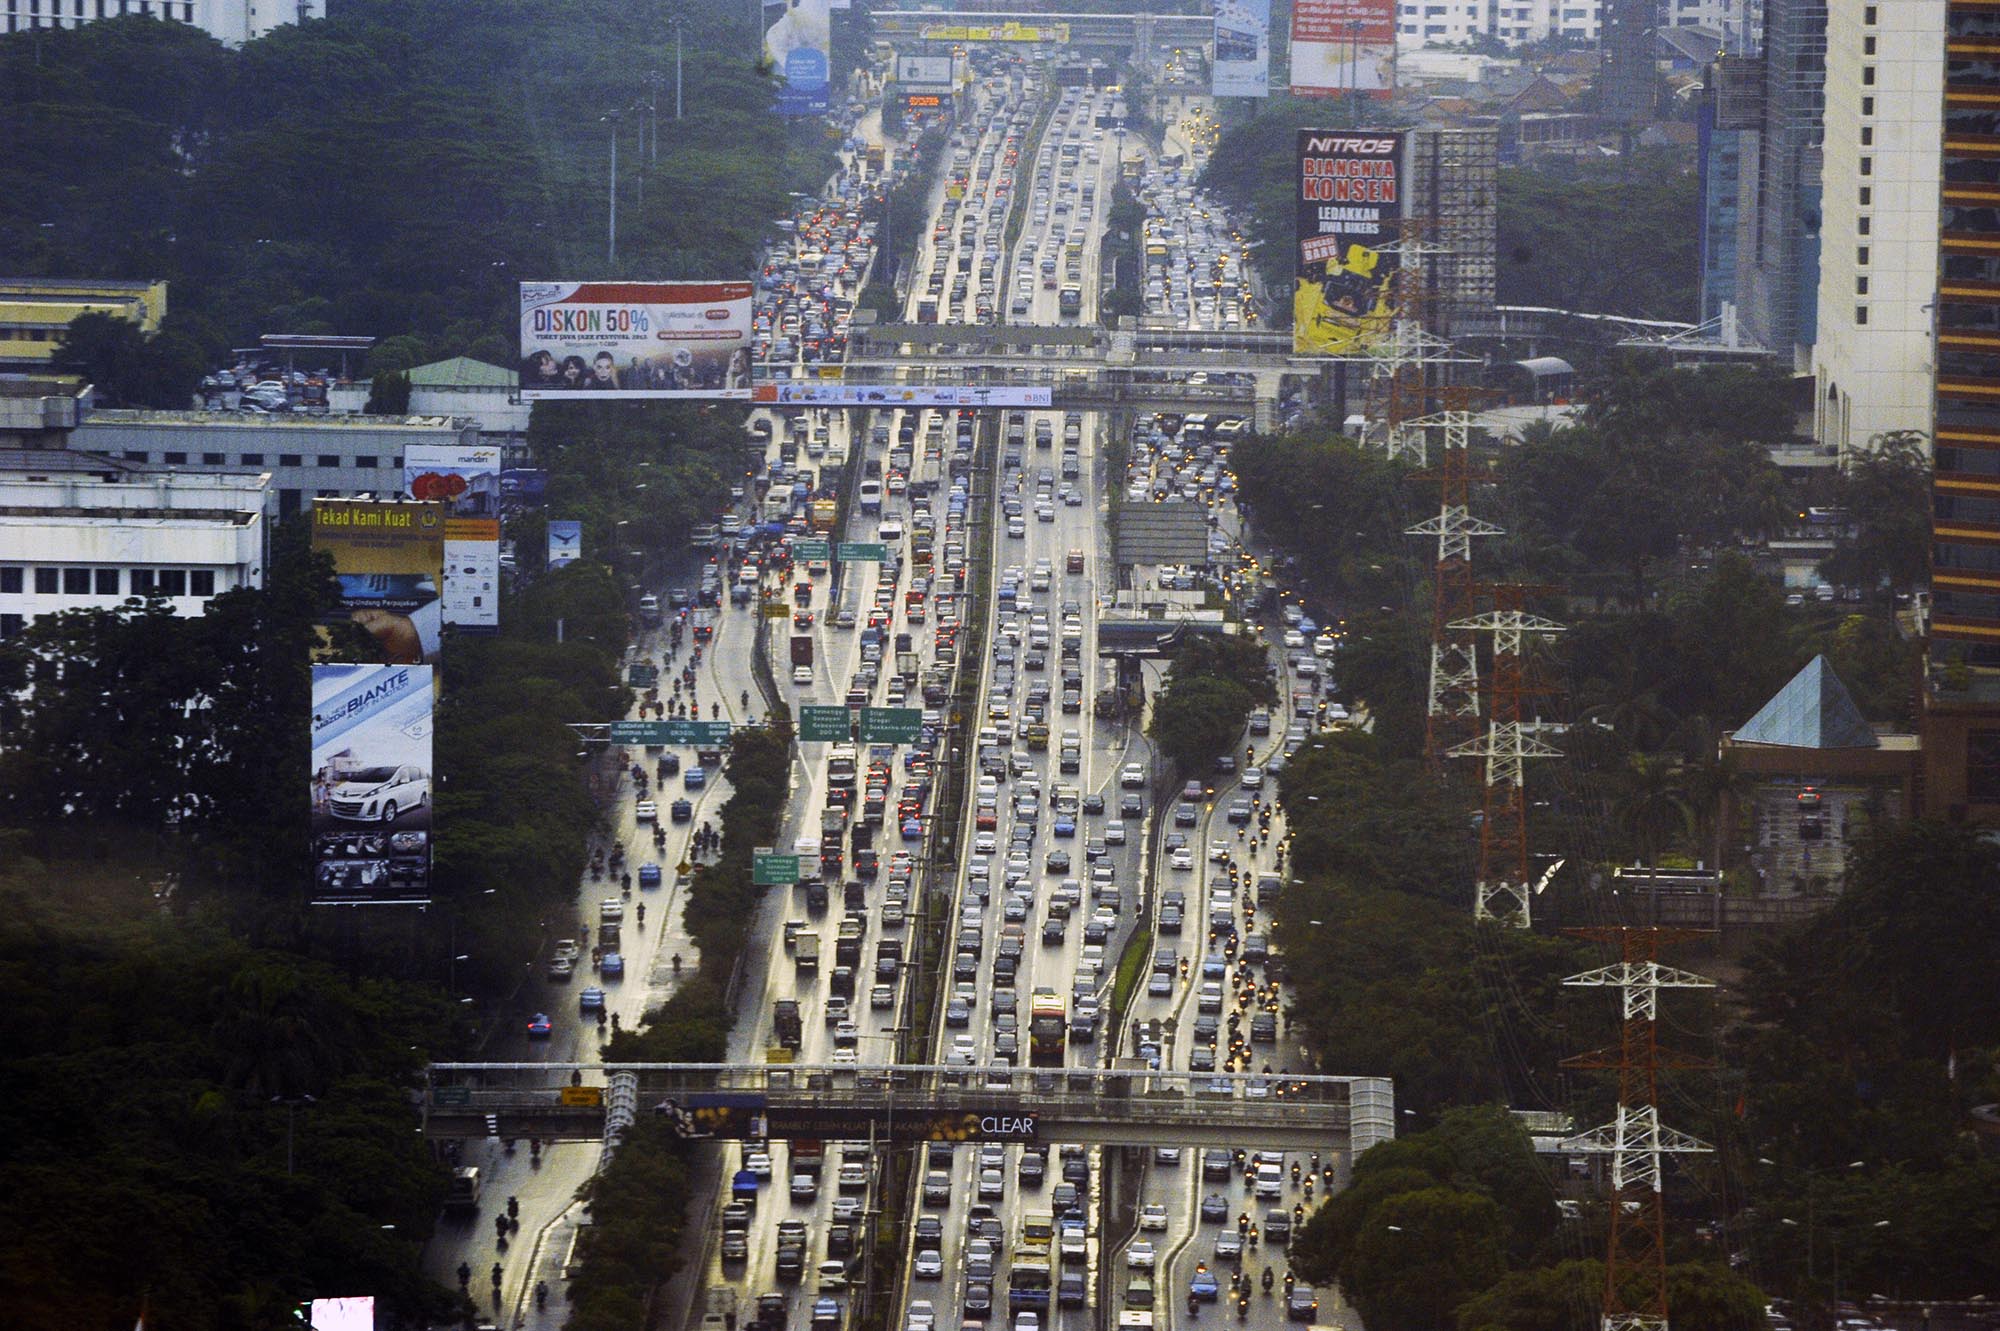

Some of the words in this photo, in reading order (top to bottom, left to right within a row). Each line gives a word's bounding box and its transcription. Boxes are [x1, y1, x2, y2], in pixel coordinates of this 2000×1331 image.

[1307, 138, 1395, 153] NITROS
[1303, 157, 1395, 179] BIANGNYA
[1303, 177, 1396, 203] KONSEN
[1318, 207, 1380, 220] LEDAKKAN
[534, 309, 600, 332] DISKON
[606, 309, 649, 332] 50%
[1032, 389, 1049, 402] BNI
[457, 455, 489, 463] mandiri
[316, 508, 349, 525] Tekad
[353, 509, 381, 526] Kami
[384, 510, 412, 527] Kuat
[347, 669, 409, 713] BIANTE
[980, 1117, 1034, 1134] CLEAR
